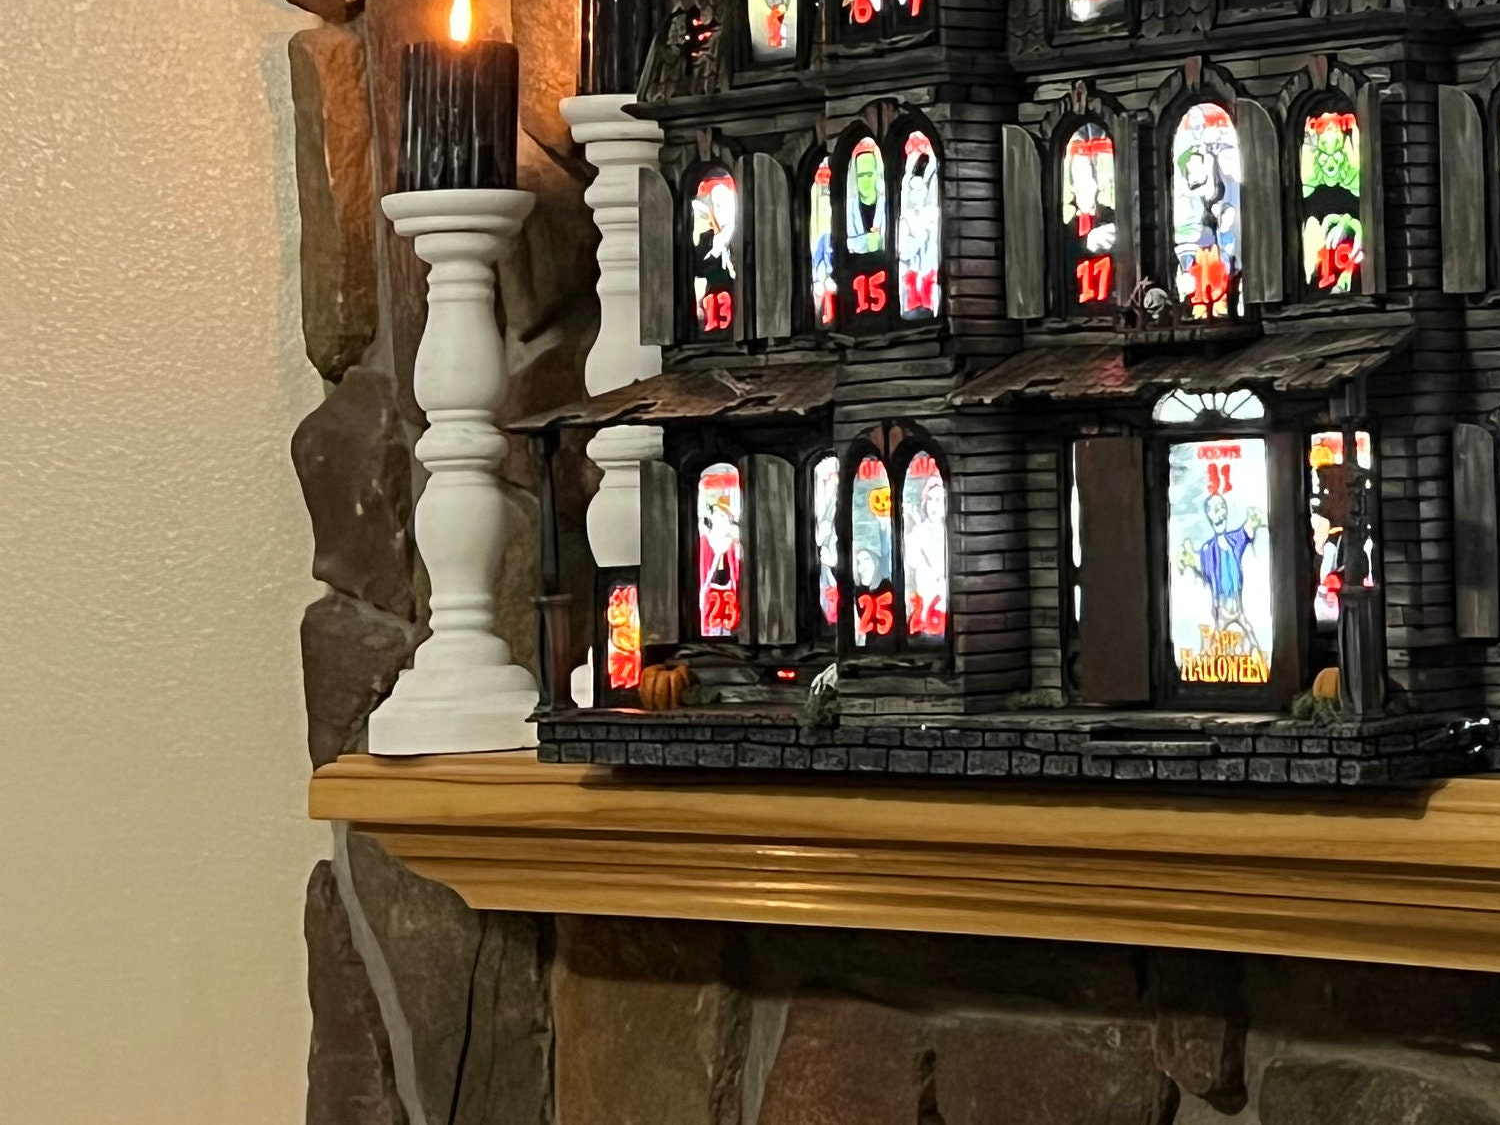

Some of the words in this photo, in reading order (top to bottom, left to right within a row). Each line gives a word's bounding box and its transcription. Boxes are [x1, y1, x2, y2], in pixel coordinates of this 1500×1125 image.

[703, 290, 732, 331] 13
[853, 270, 888, 313] 15
[705, 589, 740, 631] 23
[857, 591, 894, 635] 25
